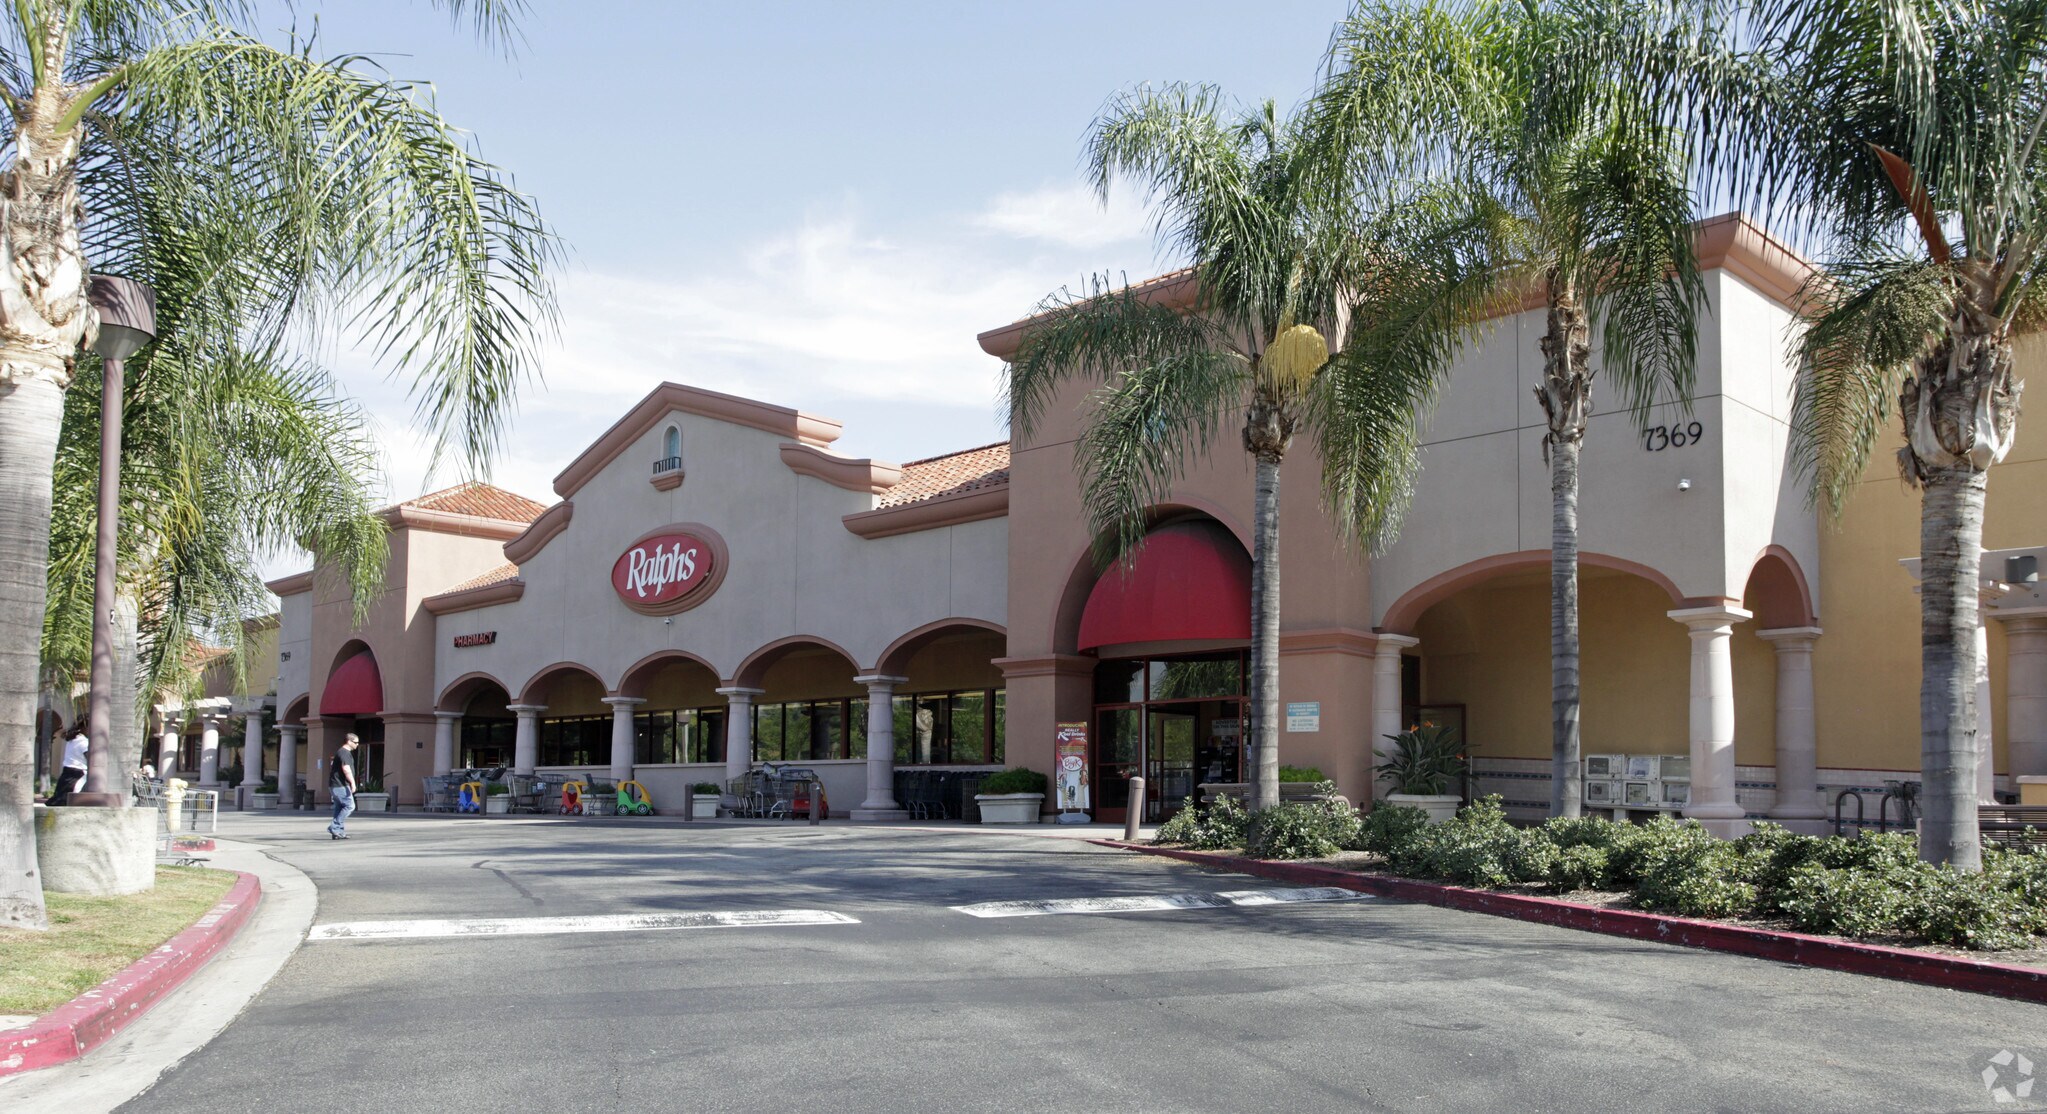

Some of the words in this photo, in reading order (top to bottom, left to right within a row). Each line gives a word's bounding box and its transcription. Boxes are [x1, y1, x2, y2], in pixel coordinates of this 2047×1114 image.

[1644, 422, 1702, 451] 7369
[626, 542, 697, 598] Ralphs
[454, 631, 496, 648] PHARMACY
